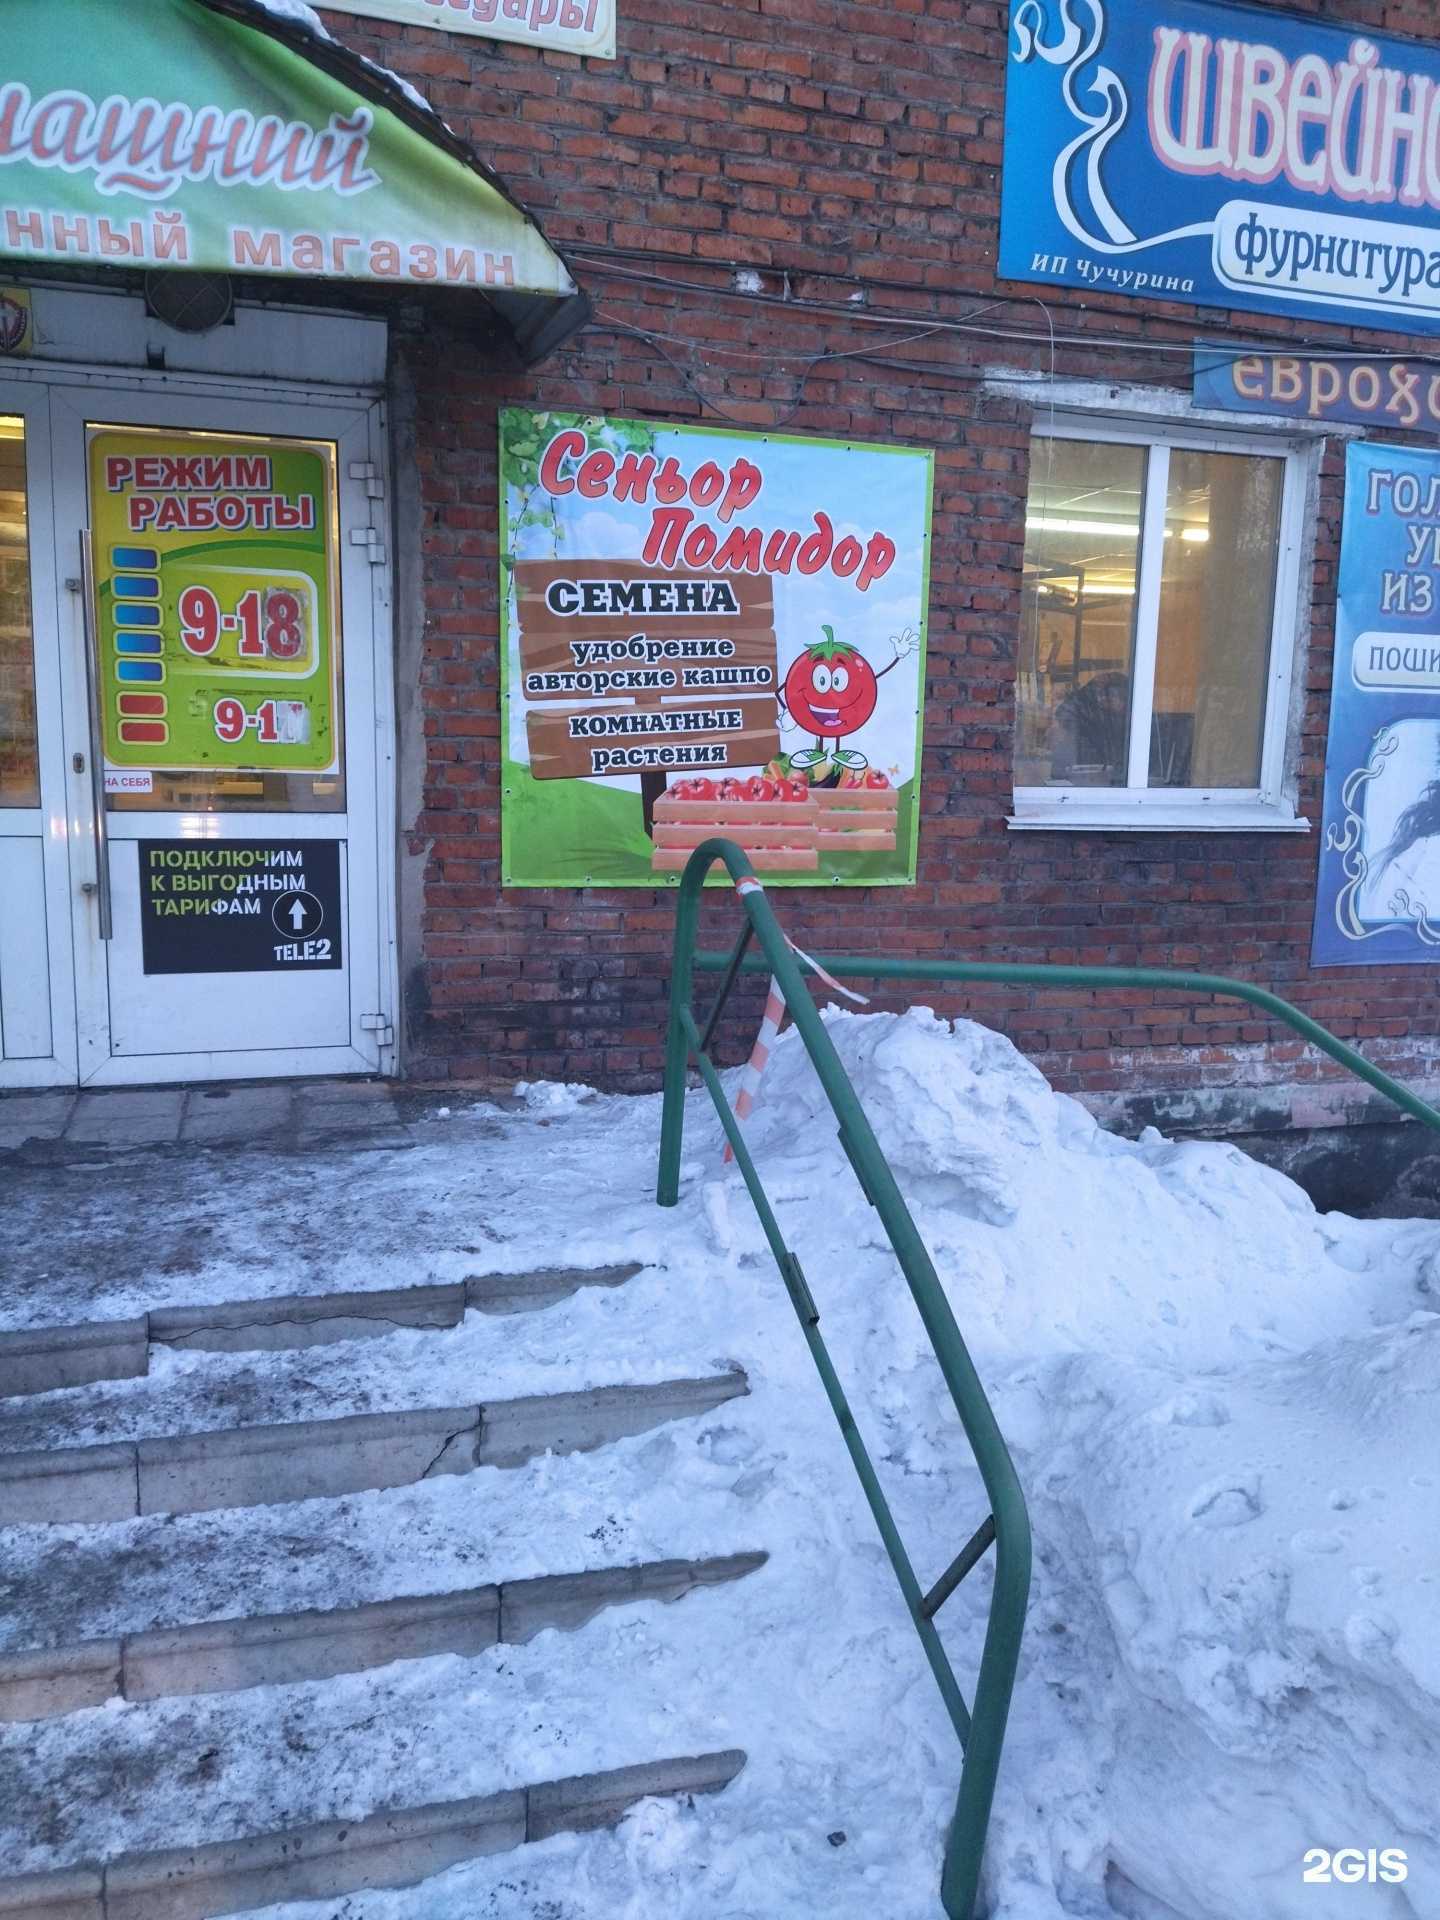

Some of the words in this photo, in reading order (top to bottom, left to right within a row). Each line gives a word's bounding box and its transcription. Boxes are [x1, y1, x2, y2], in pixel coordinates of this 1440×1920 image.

[233, 229, 516, 286] магазин
[1030, 253, 1068, 273] ИП
[1076, 257, 1195, 293] Чучурина
[106, 456, 272, 491] РЕЖИМ
[538, 429, 765, 524] Сеньор
[128, 495, 314, 531] РАБОТЫ
[640, 507, 898, 593] Помидор
[545, 580, 740, 616] СЕМЕНА
[1381, 572, 1434, 614] ИЗ
[179, 586, 304, 658] 9-18
[571, 635, 735, 667] удобрение
[527, 673, 677, 694] авторские
[683, 667, 773, 688] кашпо
[592, 746, 727, 771] растения
[121, 777, 151, 787] СЕБЯ
[150, 850, 303, 869] ПОДКЛЮЧИМ
[150, 874, 164, 892] К
[172, 874, 306, 894] ВЫГОДНЫМ
[152, 898, 261, 917] ТАРИФАМ
[273, 939, 332, 961] TELE2
